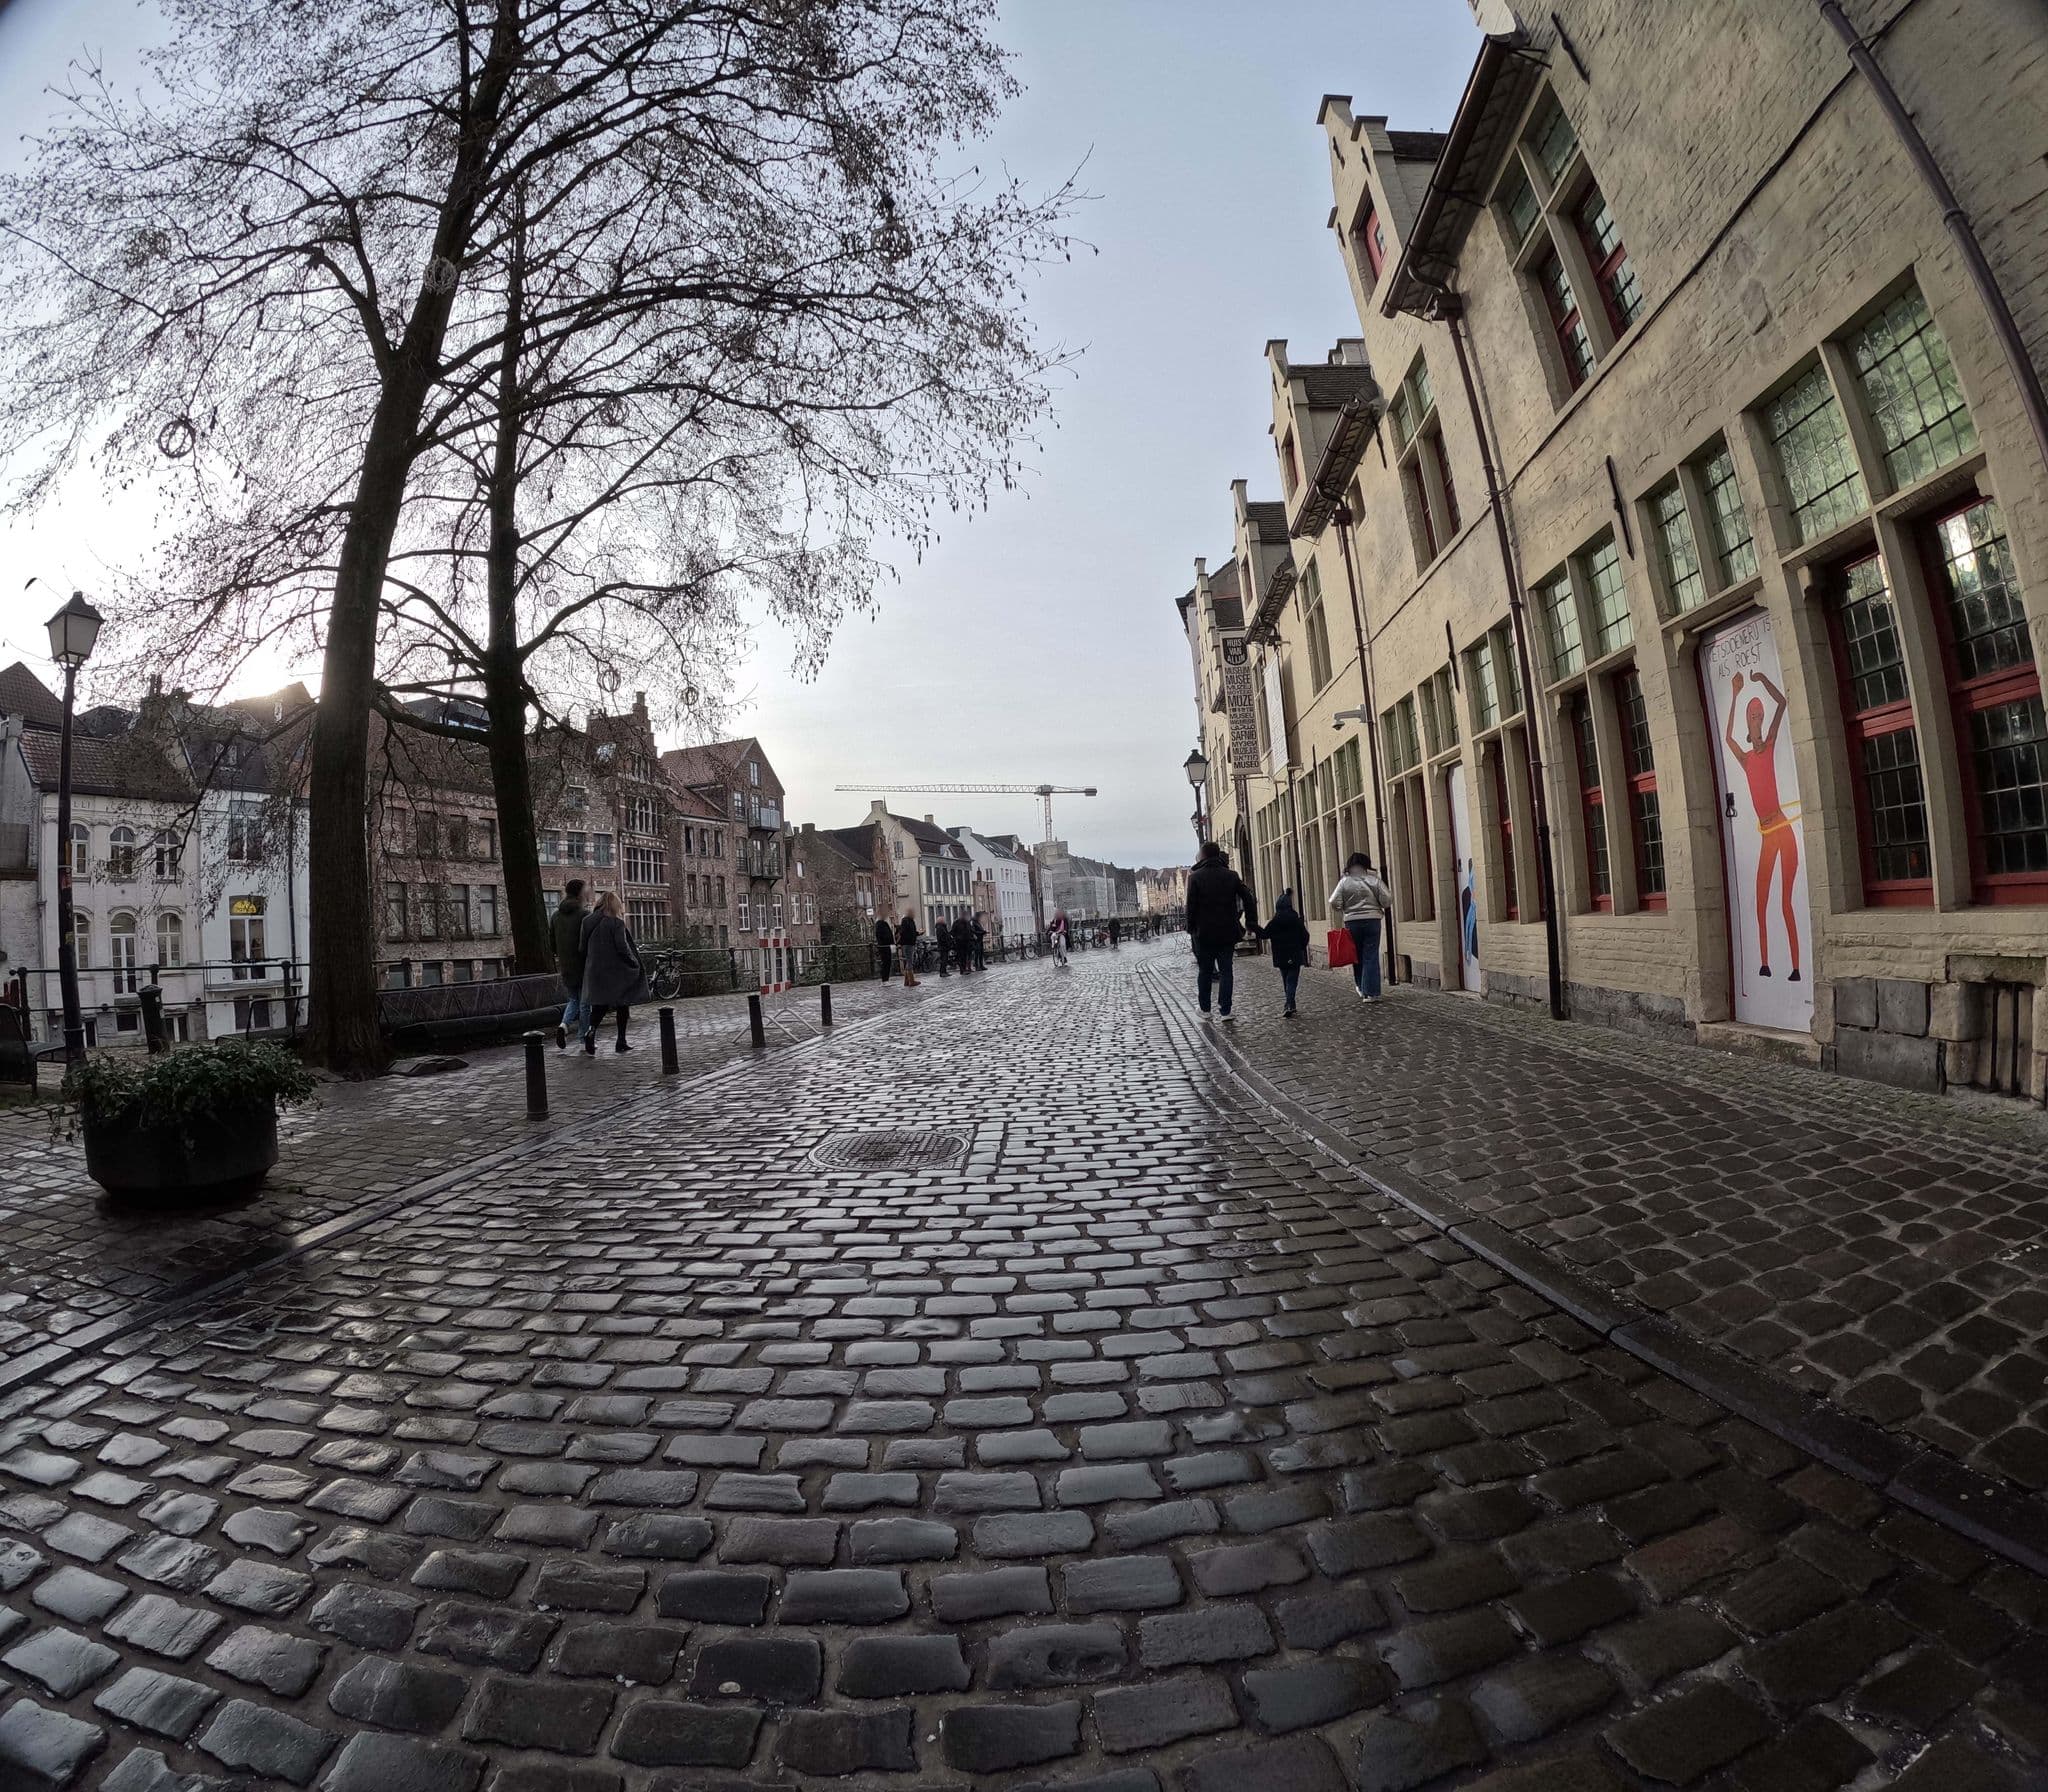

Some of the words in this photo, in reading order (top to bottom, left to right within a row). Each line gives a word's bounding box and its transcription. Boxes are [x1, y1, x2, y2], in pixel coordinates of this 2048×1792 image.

[1226, 639, 1242, 647] HUIS
[1228, 647, 1242, 655] VAN
[1735, 641, 1762, 668] ROEST
[1233, 760, 1260, 769] MUSEO
